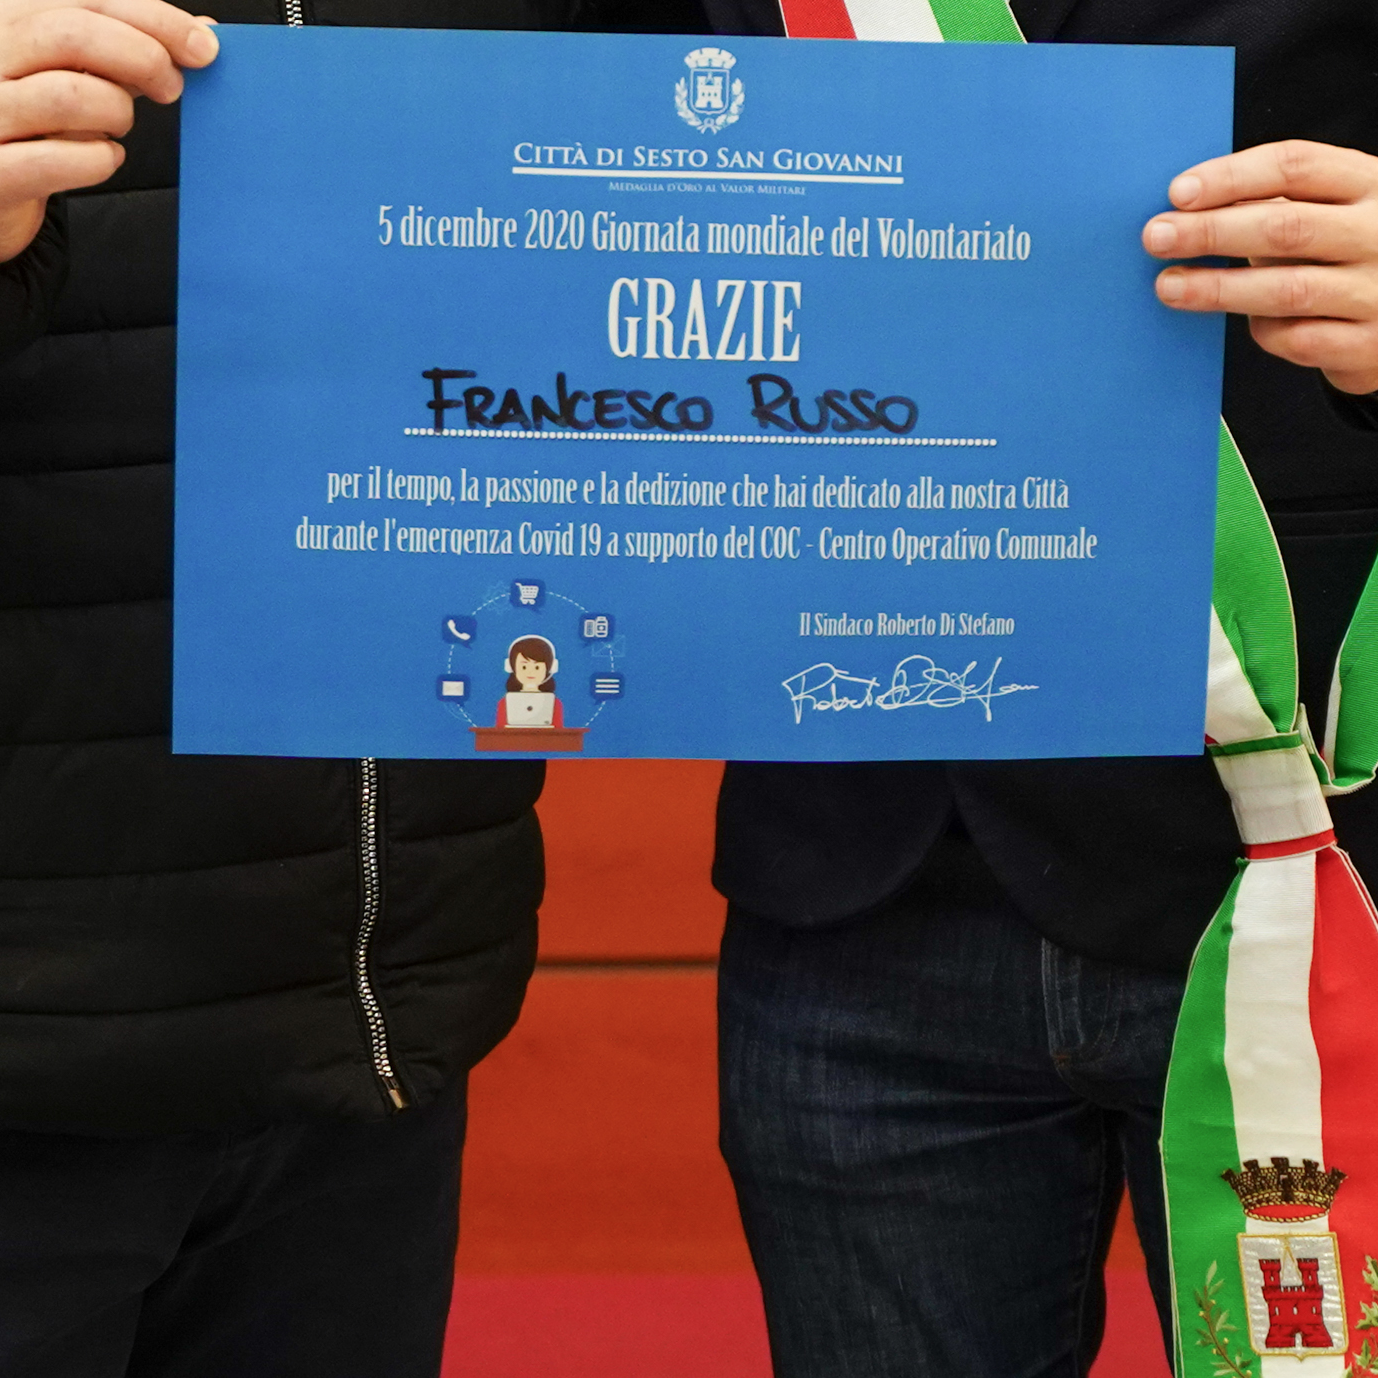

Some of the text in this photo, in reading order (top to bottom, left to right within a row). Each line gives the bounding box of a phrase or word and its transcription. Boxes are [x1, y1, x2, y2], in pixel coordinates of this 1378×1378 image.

[379, 205, 1030, 260] 5 dicembre 2020 Giornata mondiale del Volontariato
[608, 278, 801, 361] GRAZIE
[421, 367, 920, 435] FRANCESCO RUSSO
[328, 466, 1069, 509] per il tempo, la passione e la dedizione che hai dedicato alla nostra Città
[296, 516, 378, 551] durante
[519, 522, 574, 555] Covid
[580, 523, 601, 556] 19
[607, 532, 619, 556] a
[625, 528, 717, 561] supporto
[724, 526, 754, 558] del
[761, 526, 800, 559] COC
[820, 527, 886, 559] Centro
[892, 527, 990, 564] Operativo
[996, 527, 1097, 559] Comunale
[800, 613, 1014, 636] Il Sindaco Roberto Di Stefano
